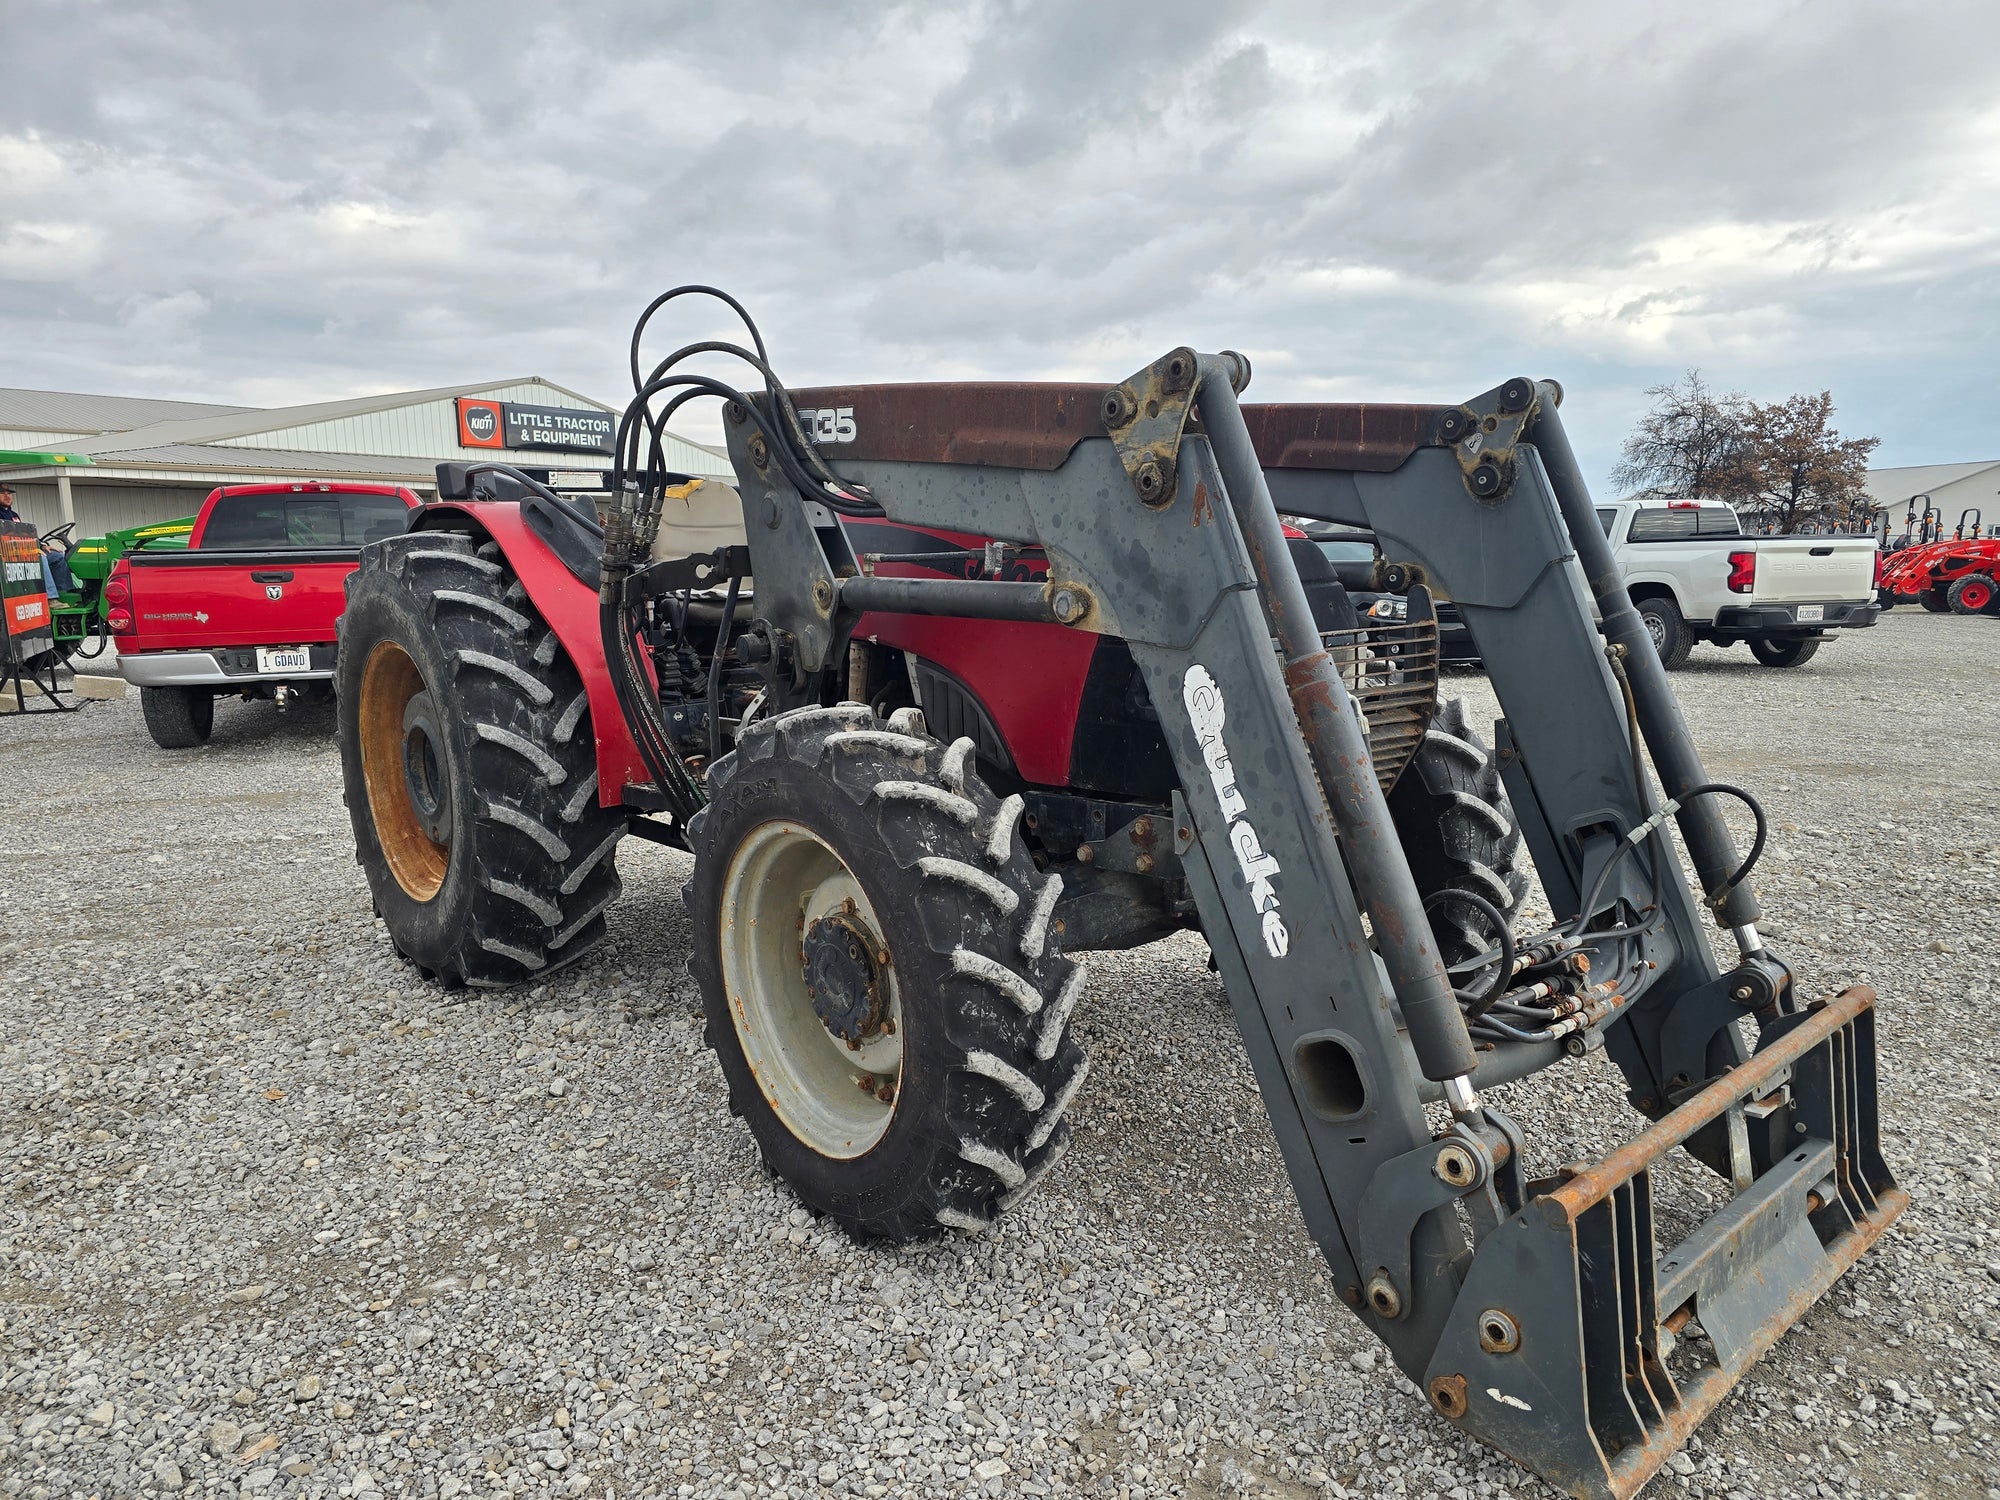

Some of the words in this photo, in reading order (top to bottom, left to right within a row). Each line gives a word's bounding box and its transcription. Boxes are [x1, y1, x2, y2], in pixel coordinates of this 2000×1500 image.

[471, 414, 493, 430] KIOTI
[510, 412, 553, 427] LITTLE
[555, 416, 609, 432] TRACTOR
[521, 429, 530, 441] &
[533, 430, 602, 446] EQUIPMENT
[1771, 562, 1867, 573] CHEVROLET
[263, 656, 269, 667] 1
[274, 654, 305, 666] GDAVD
